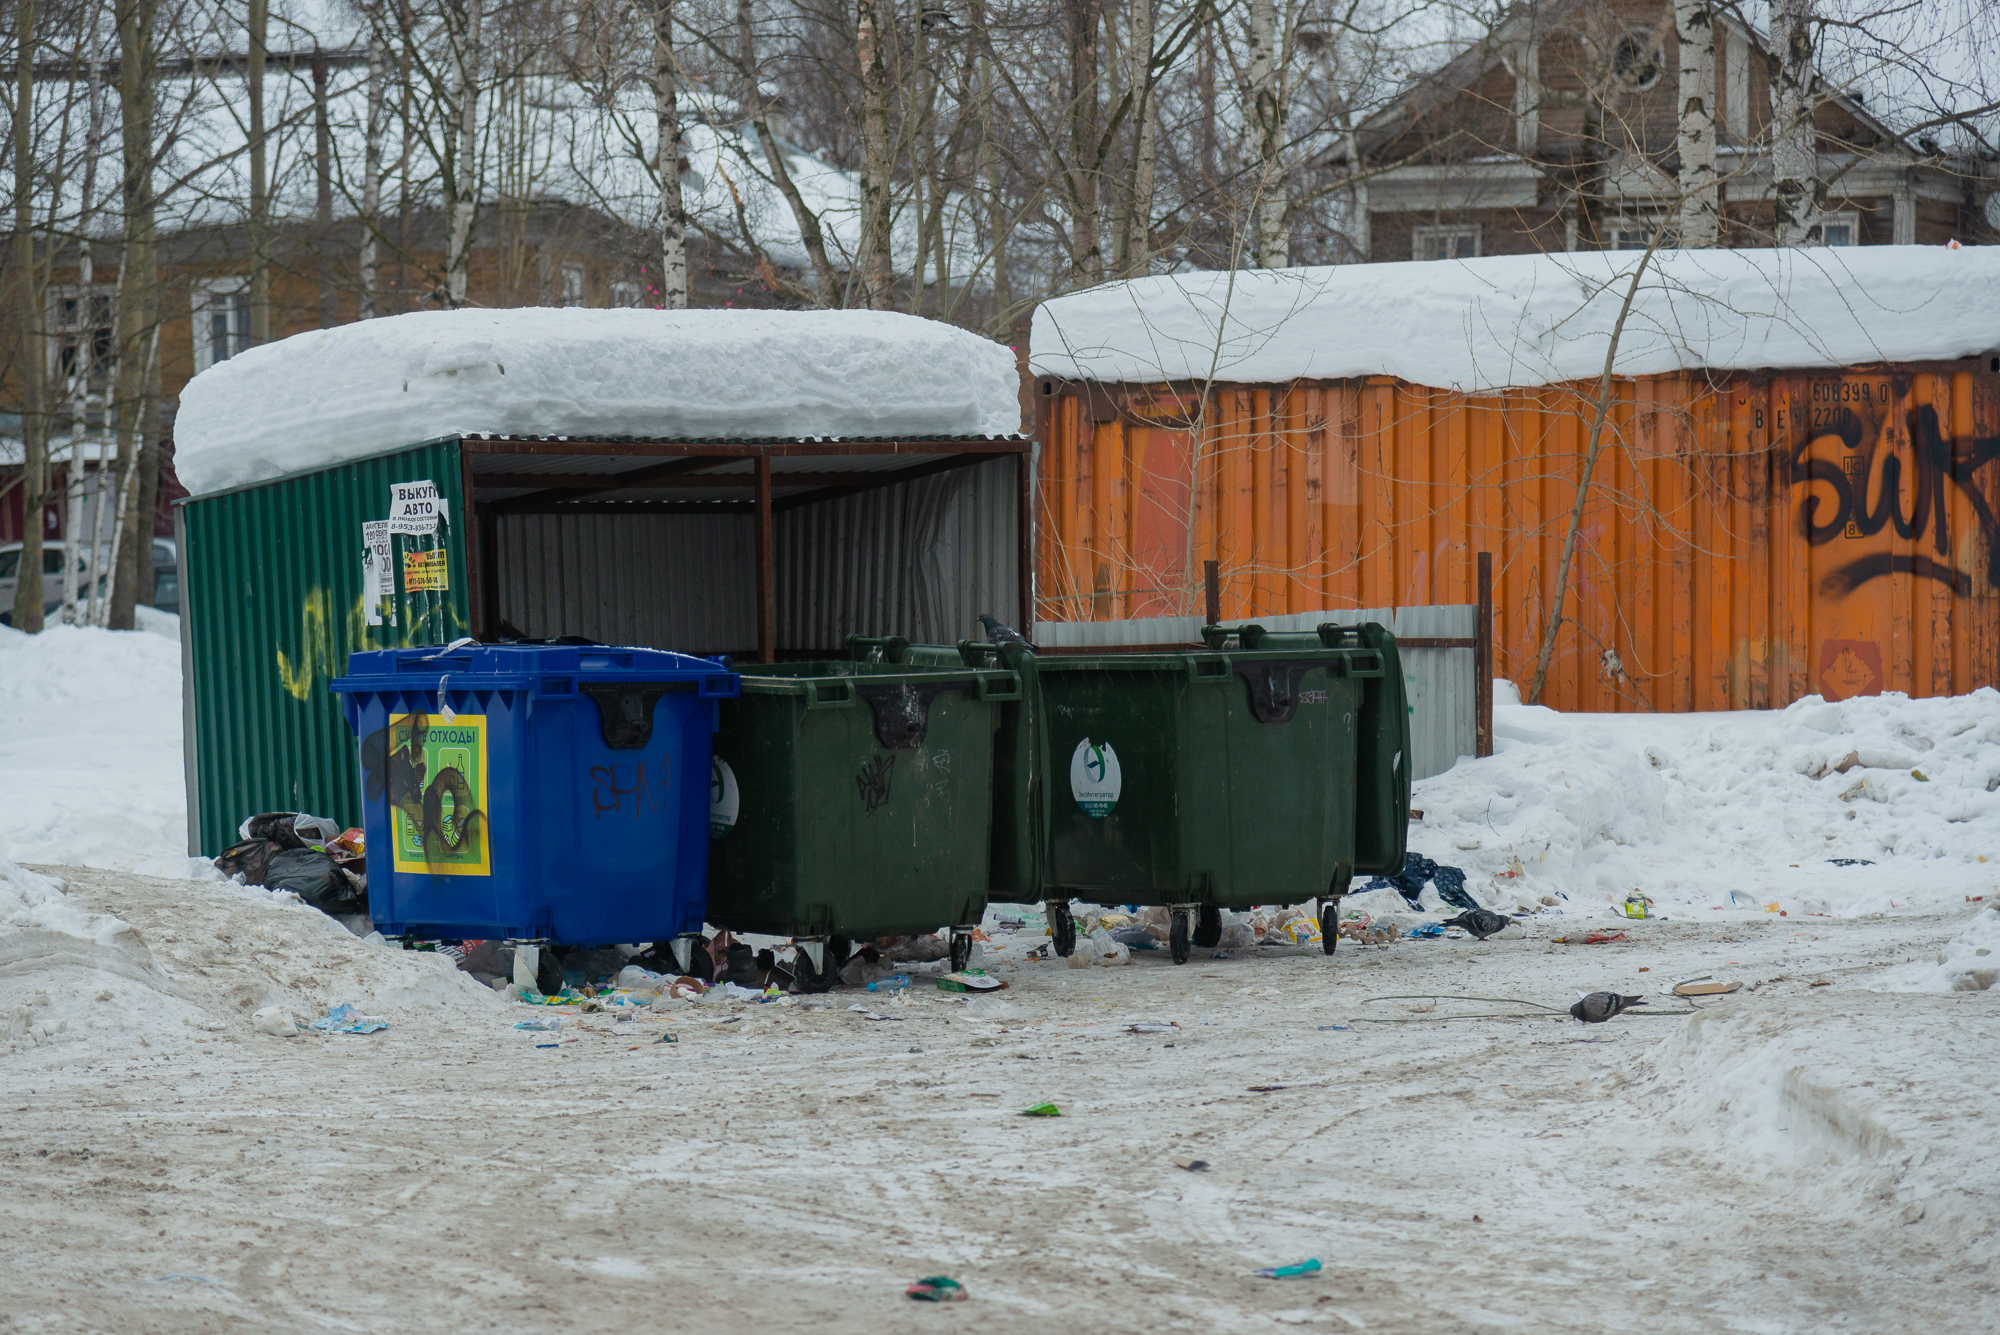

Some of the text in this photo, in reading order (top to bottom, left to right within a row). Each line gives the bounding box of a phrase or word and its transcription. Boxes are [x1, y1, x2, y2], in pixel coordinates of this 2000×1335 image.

[1879, 383, 1888, 403] 0
[399, 486, 436, 500] ВЫКУП
[403, 501, 433, 516] АВТО
[430, 730, 475, 745] ОТХОДЫ
